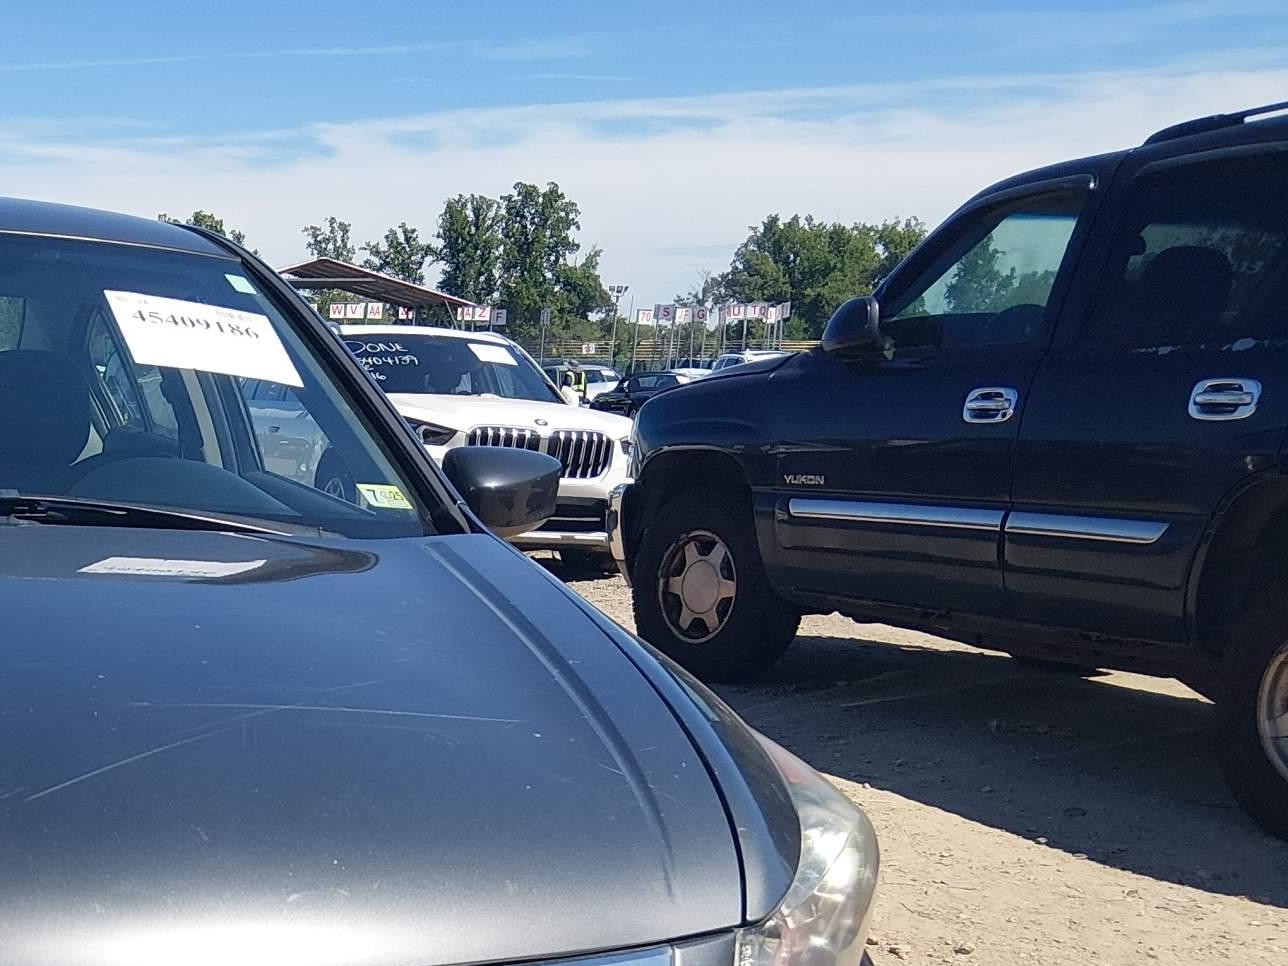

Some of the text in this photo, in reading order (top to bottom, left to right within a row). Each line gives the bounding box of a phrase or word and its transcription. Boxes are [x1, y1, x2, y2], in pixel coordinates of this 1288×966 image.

[331, 305, 343, 315] W
[350, 305, 358, 315] V
[369, 305, 381, 316] AA
[478, 307, 486, 318] Z
[662, 306, 670, 317] S
[696, 308, 706, 320] G
[732, 304, 741, 316] U
[496, 311, 504, 322] F
[641, 311, 652, 322] 70
[132, 309, 260, 340] 45409186
[344, 340, 409, 355] DONE
[783, 474, 825, 485] YUKON
